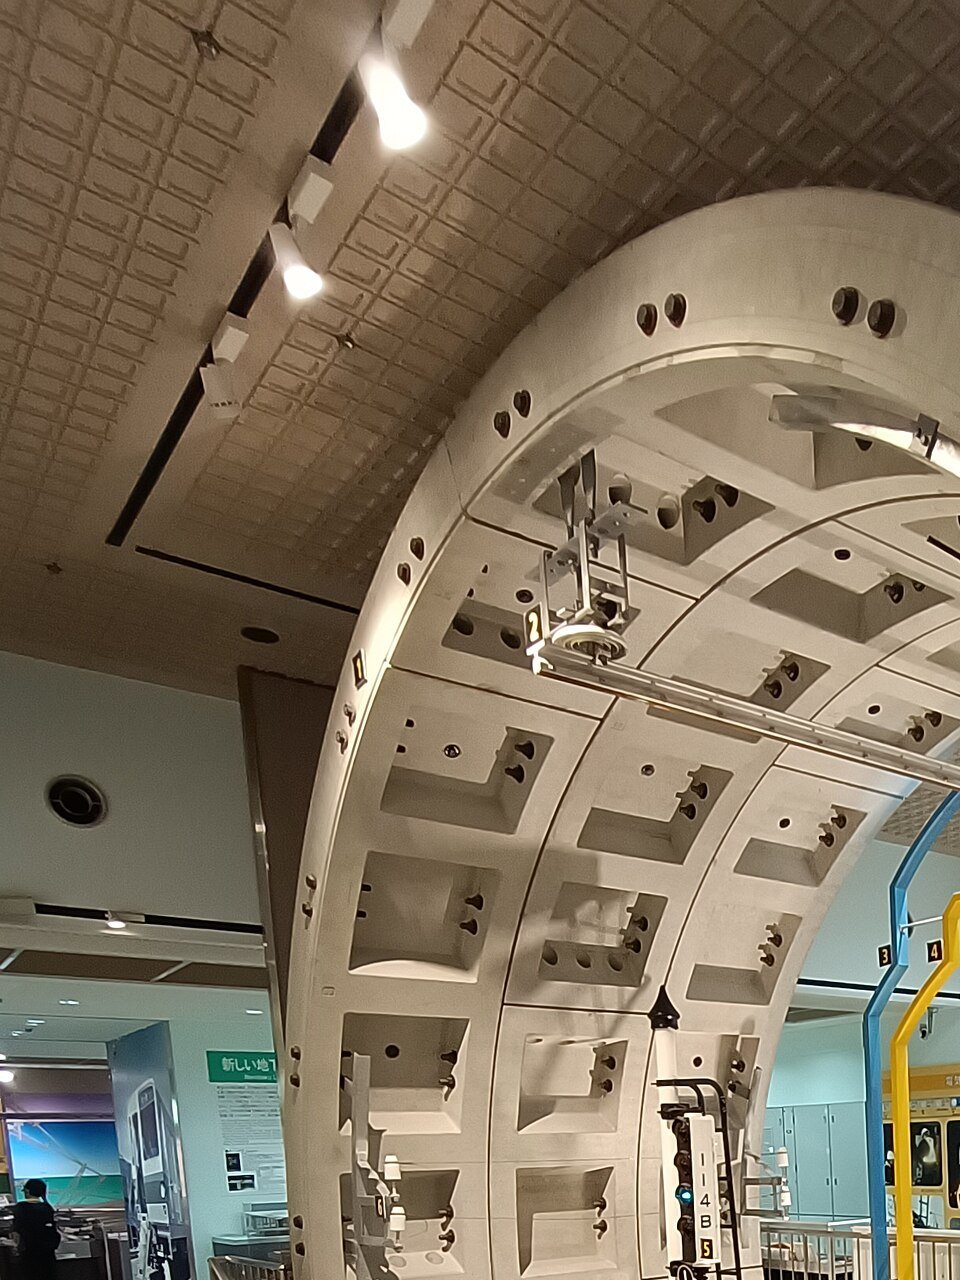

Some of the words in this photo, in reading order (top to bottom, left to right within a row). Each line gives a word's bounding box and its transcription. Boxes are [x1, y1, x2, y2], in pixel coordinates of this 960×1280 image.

[528, 612, 539, 642] 2
[356, 657, 362, 679] 1
[882, 949, 888, 964] 3
[931, 944, 938, 959] 4
[377, 1198, 383, 1216] 6
[703, 1242, 710, 1256] 5
